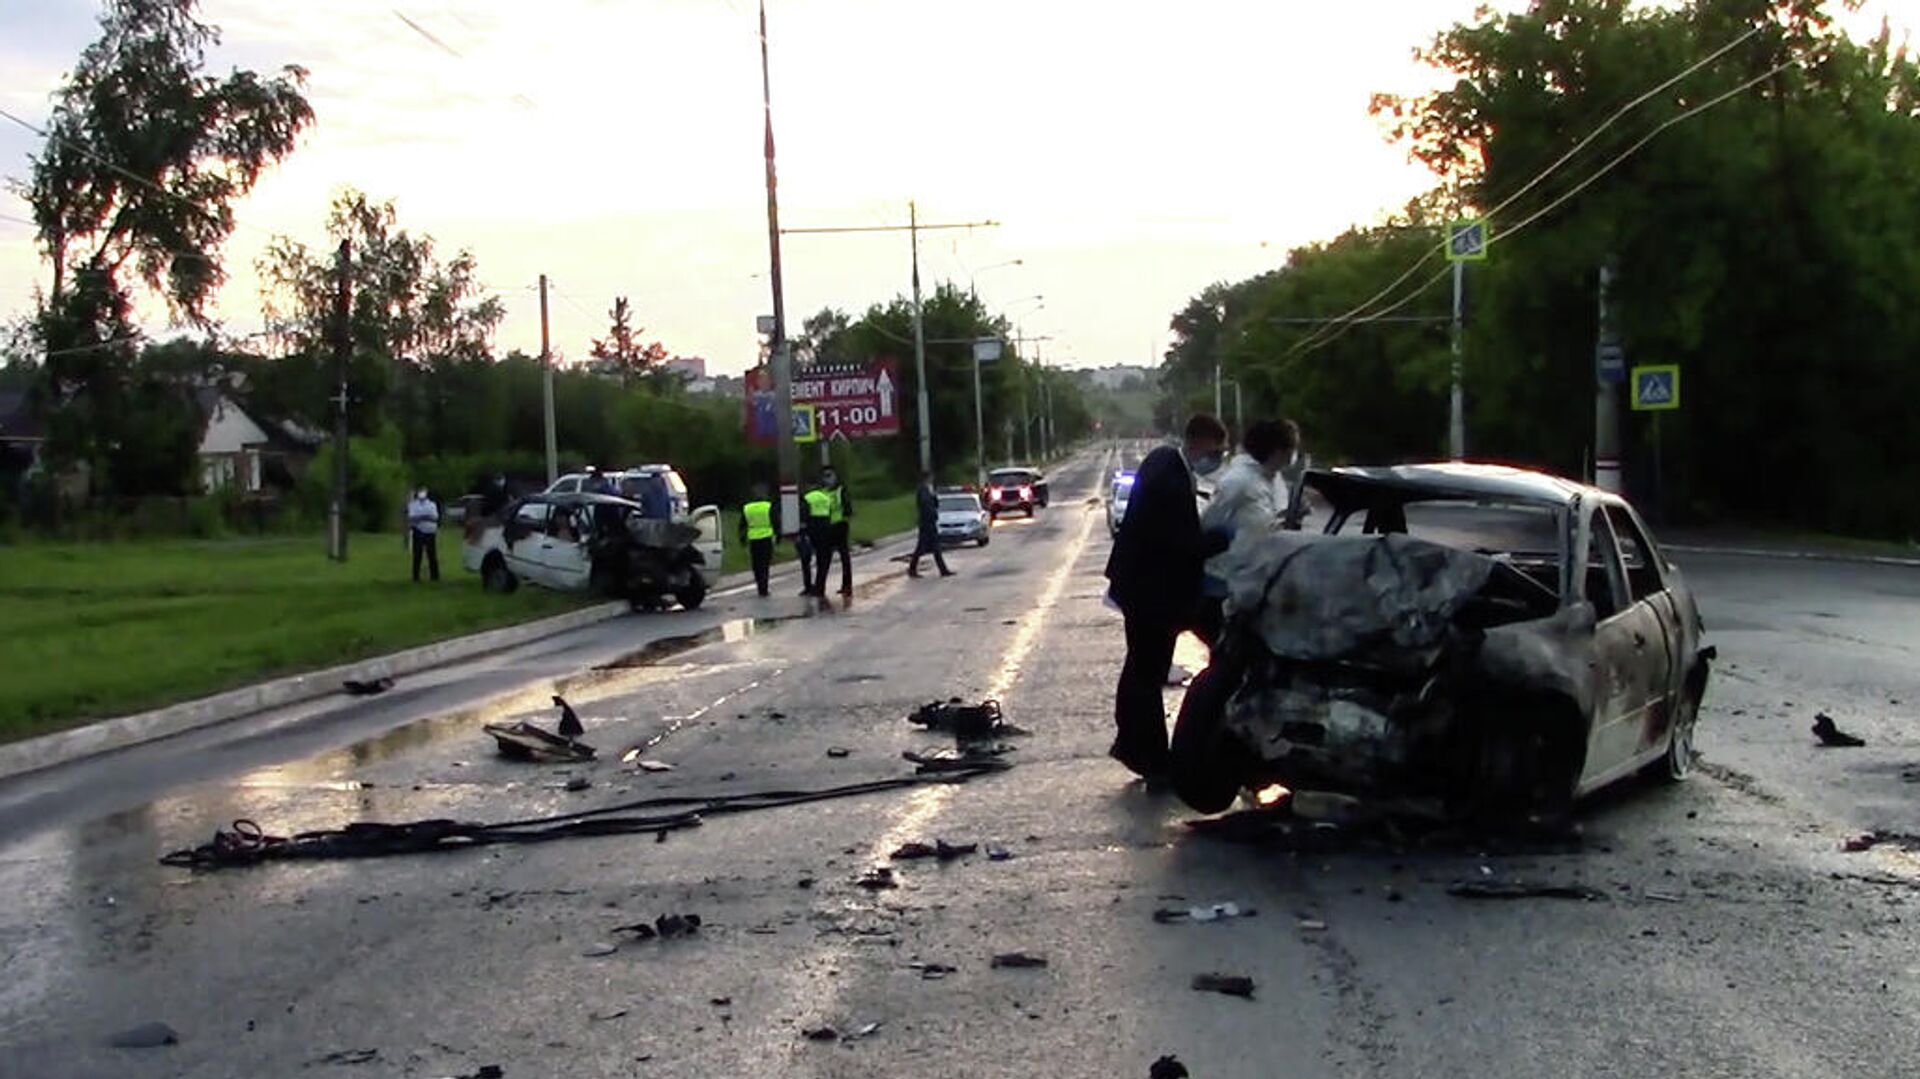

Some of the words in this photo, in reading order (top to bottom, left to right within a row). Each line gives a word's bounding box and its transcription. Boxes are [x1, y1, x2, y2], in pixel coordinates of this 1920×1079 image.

[791, 381, 825, 398] ЕМЕНТ
[831, 378, 875, 397] КИРПИЧ
[816, 407, 877, 426] 11-00
